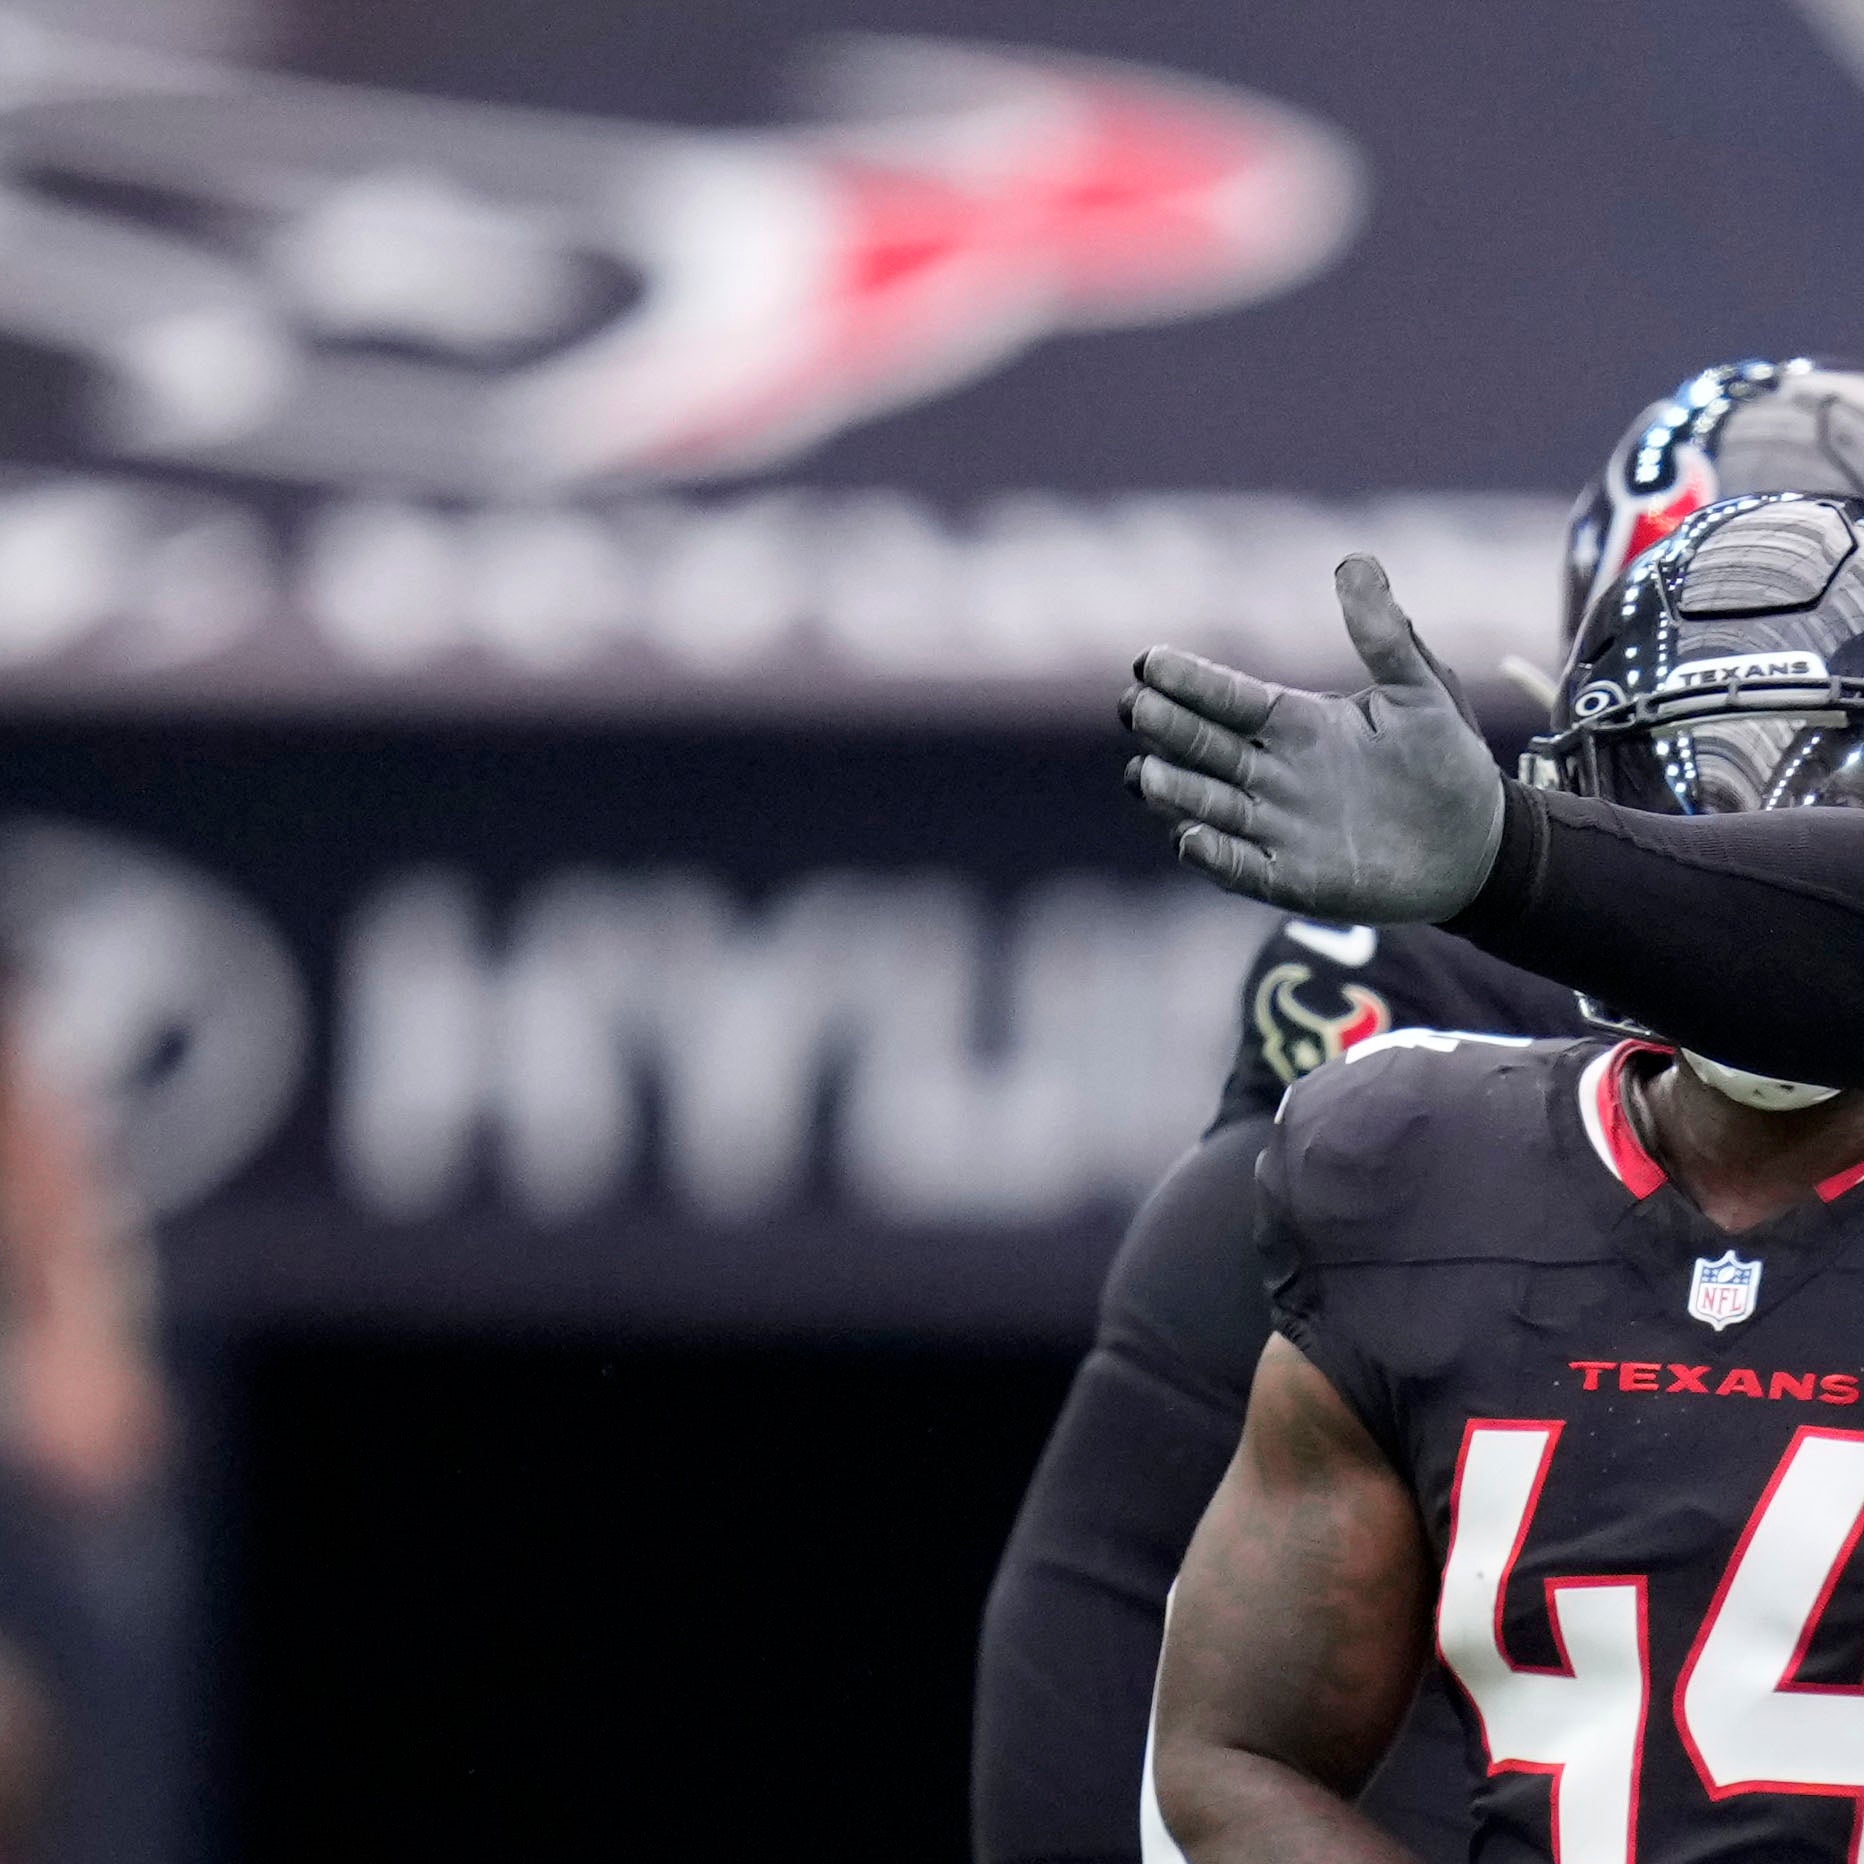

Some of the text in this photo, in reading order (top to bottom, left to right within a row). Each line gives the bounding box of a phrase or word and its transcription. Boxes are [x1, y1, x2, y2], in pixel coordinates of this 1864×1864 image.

[1679, 659, 1811, 685] TEXANS
[1701, 1286, 1742, 1315] NFL
[1568, 1360, 1862, 1405] TEXANS
